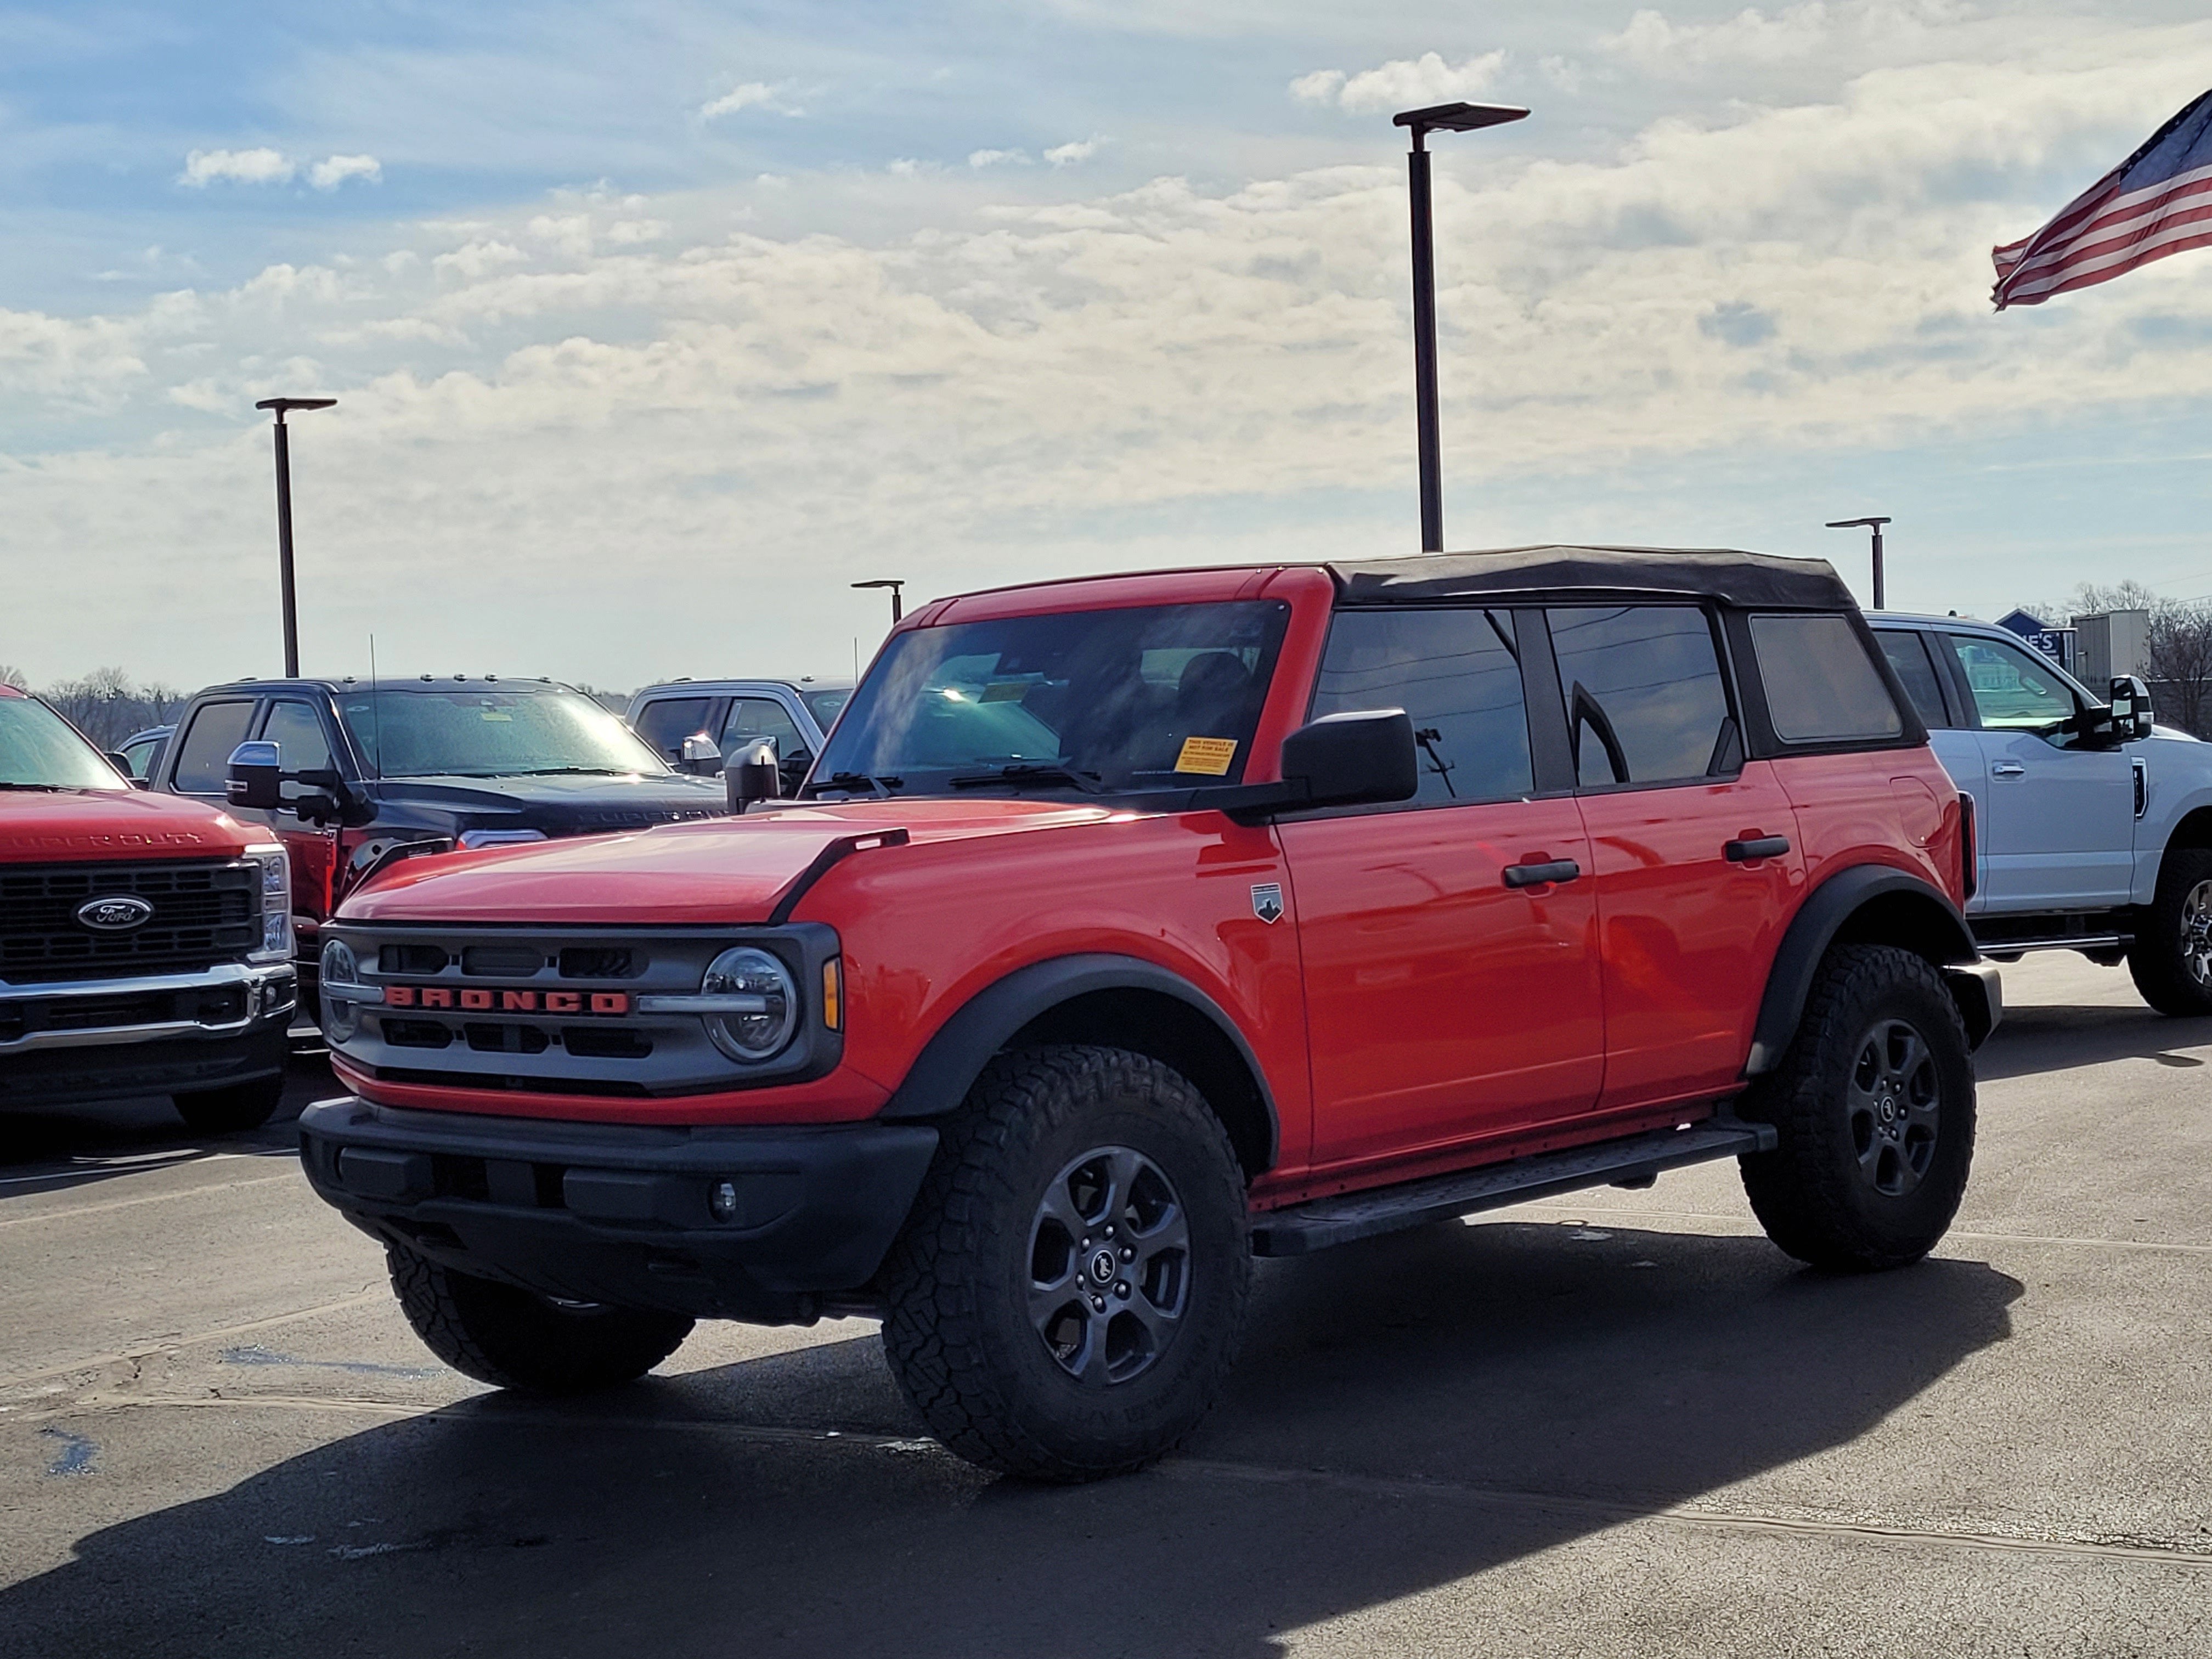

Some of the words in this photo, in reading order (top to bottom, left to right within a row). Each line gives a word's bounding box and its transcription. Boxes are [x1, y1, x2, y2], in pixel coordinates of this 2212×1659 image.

[1, 835, 113, 849] UPER
[119, 832, 207, 845] DUTY
[96, 905, 136, 923] Ford
[385, 986, 628, 1014] BRONCO
